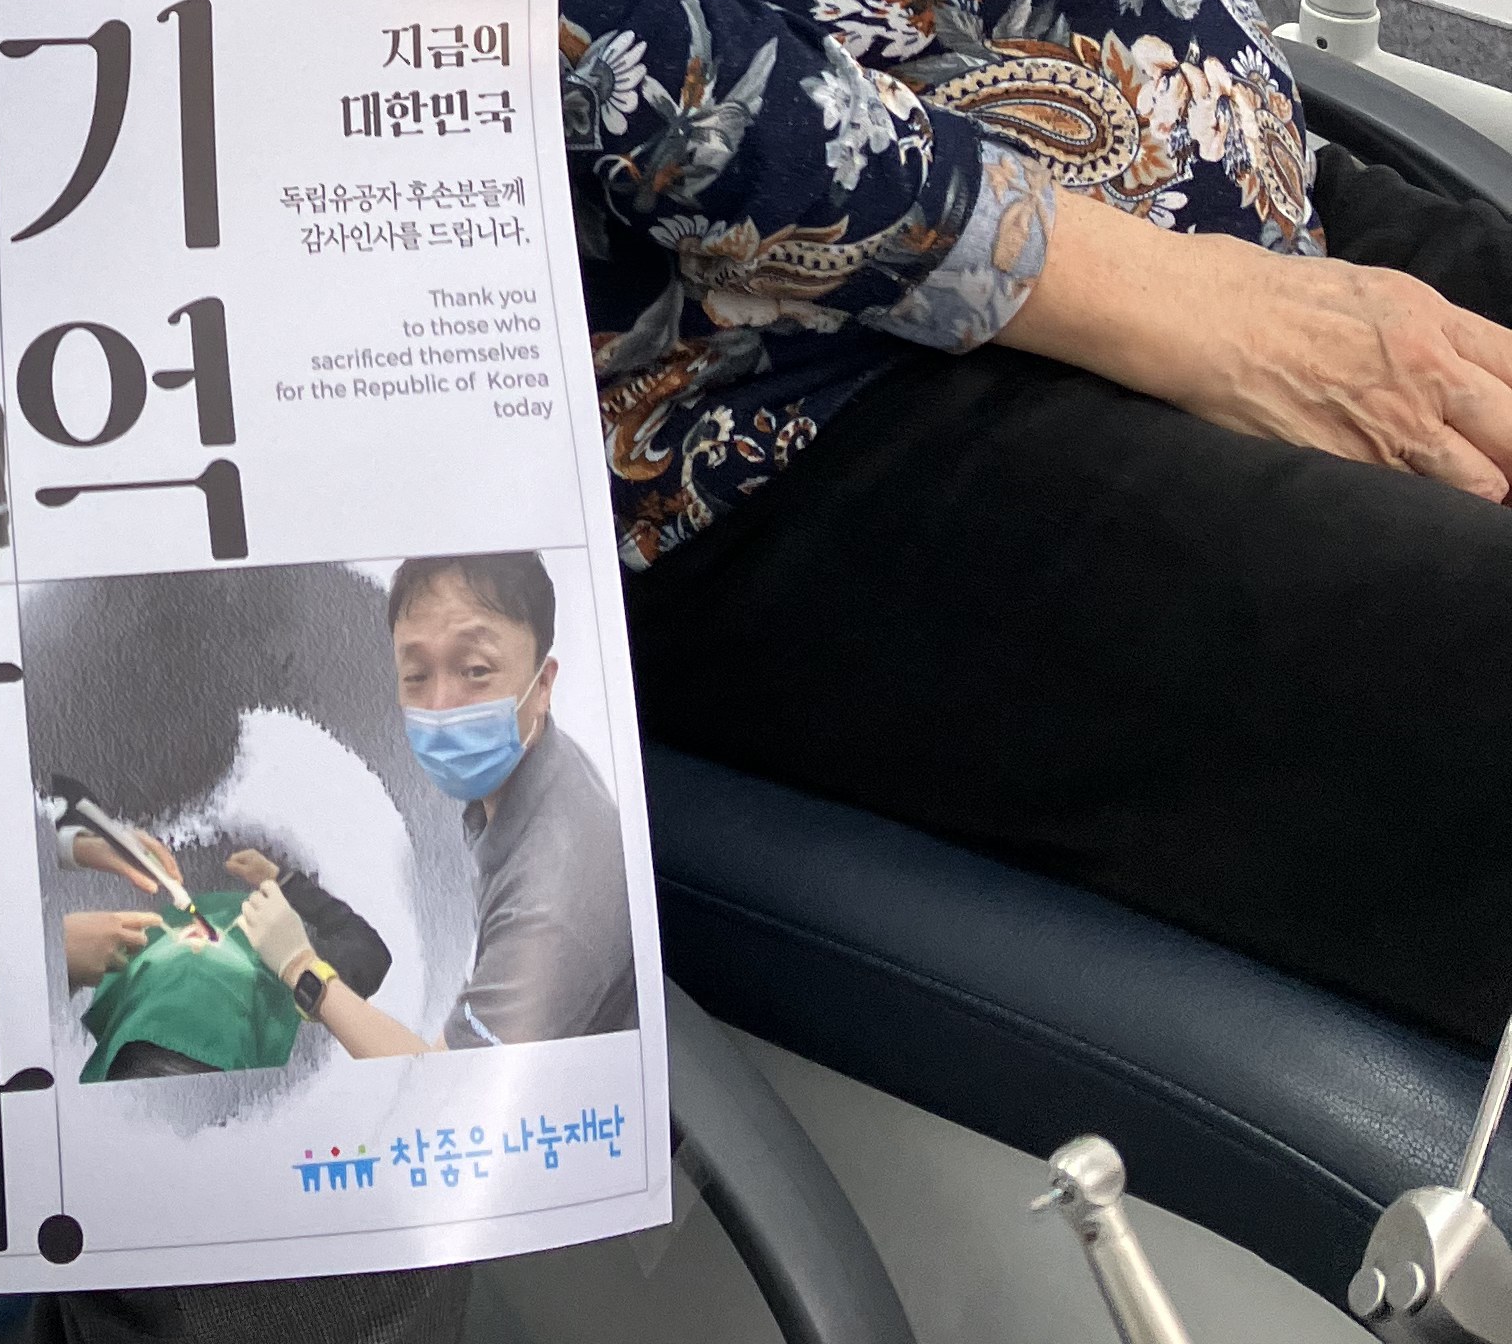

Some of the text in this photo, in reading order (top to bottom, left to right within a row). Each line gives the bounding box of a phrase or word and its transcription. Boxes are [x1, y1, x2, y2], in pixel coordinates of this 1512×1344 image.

[381, 21, 511, 70] 지금의
[340, 88, 517, 138] 대한민국
[279, 175, 526, 215] 독립유공자 후손분들께
[300, 215, 531, 256] 감사인사를 드립니다.
[428, 285, 537, 310] Thank you
[402, 312, 541, 338] to those who
[310, 341, 540, 371] sacrificed themselves
[275, 370, 550, 402] for the Republic of Korea
[493, 396, 553, 421] today
[389, 1103, 626, 1188] 참좋은 나눔재단
